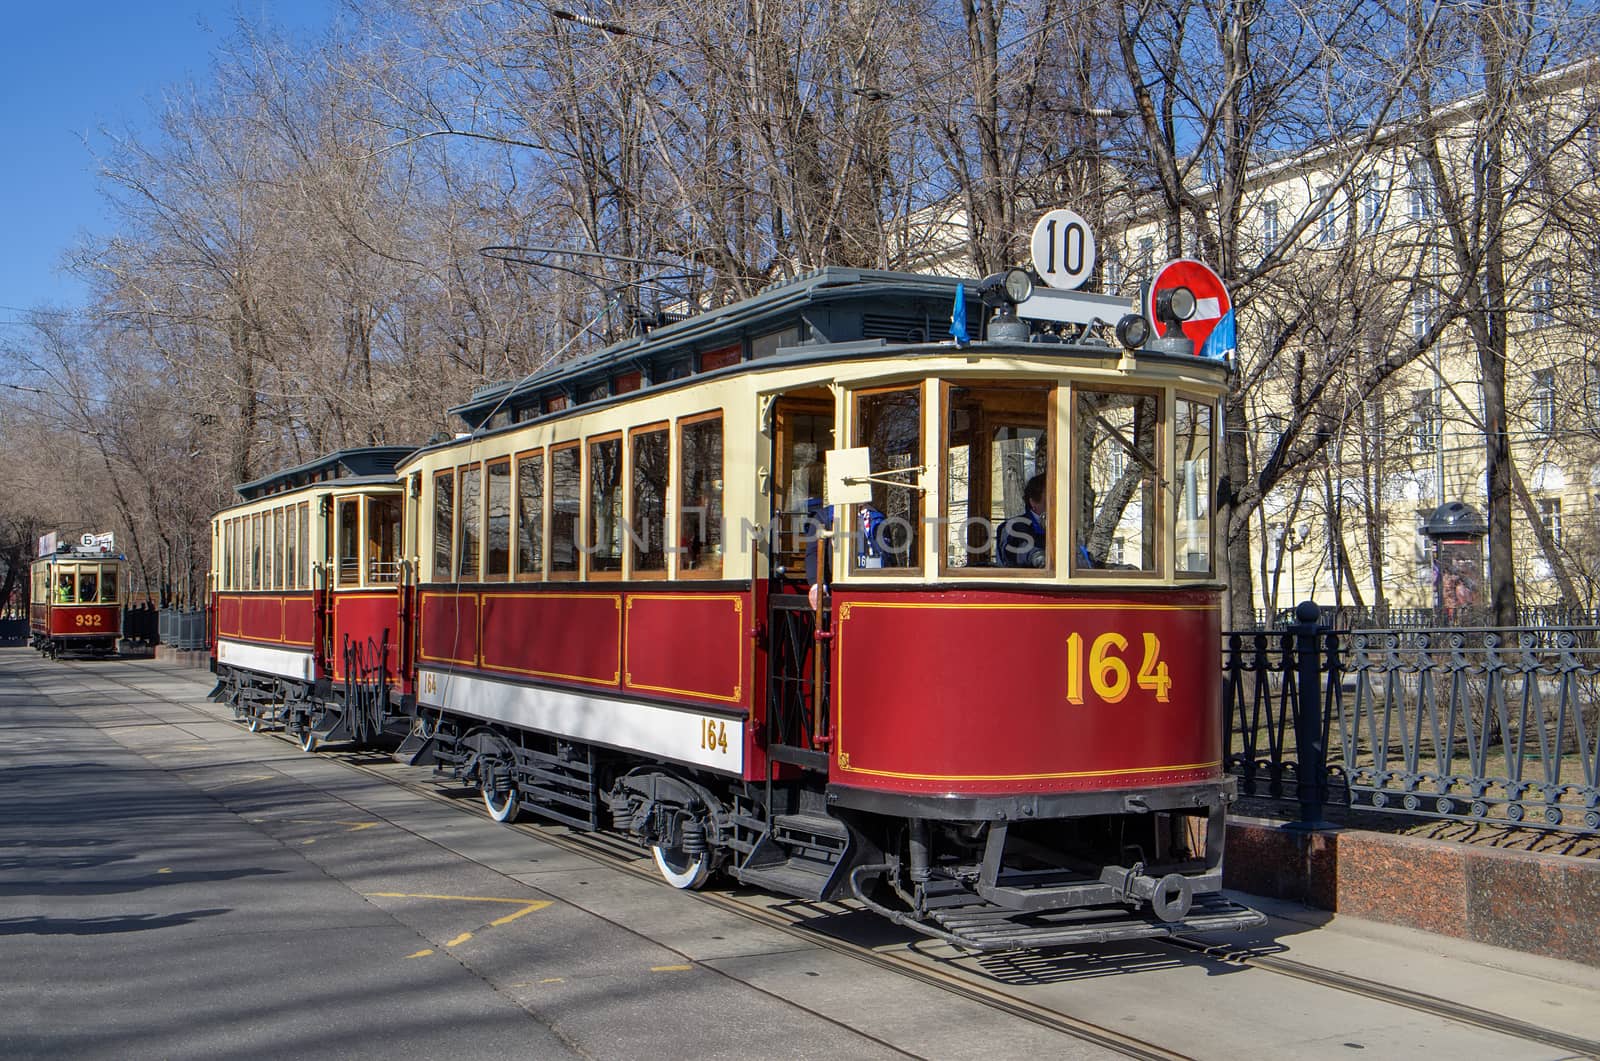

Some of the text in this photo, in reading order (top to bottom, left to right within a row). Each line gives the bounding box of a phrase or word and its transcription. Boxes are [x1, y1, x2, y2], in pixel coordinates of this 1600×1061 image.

[1047, 220, 1085, 275] 10
[75, 614, 101, 626] 932
[424, 672, 437, 695] 164
[1066, 632, 1172, 705] 164
[701, 717, 728, 754] 164
